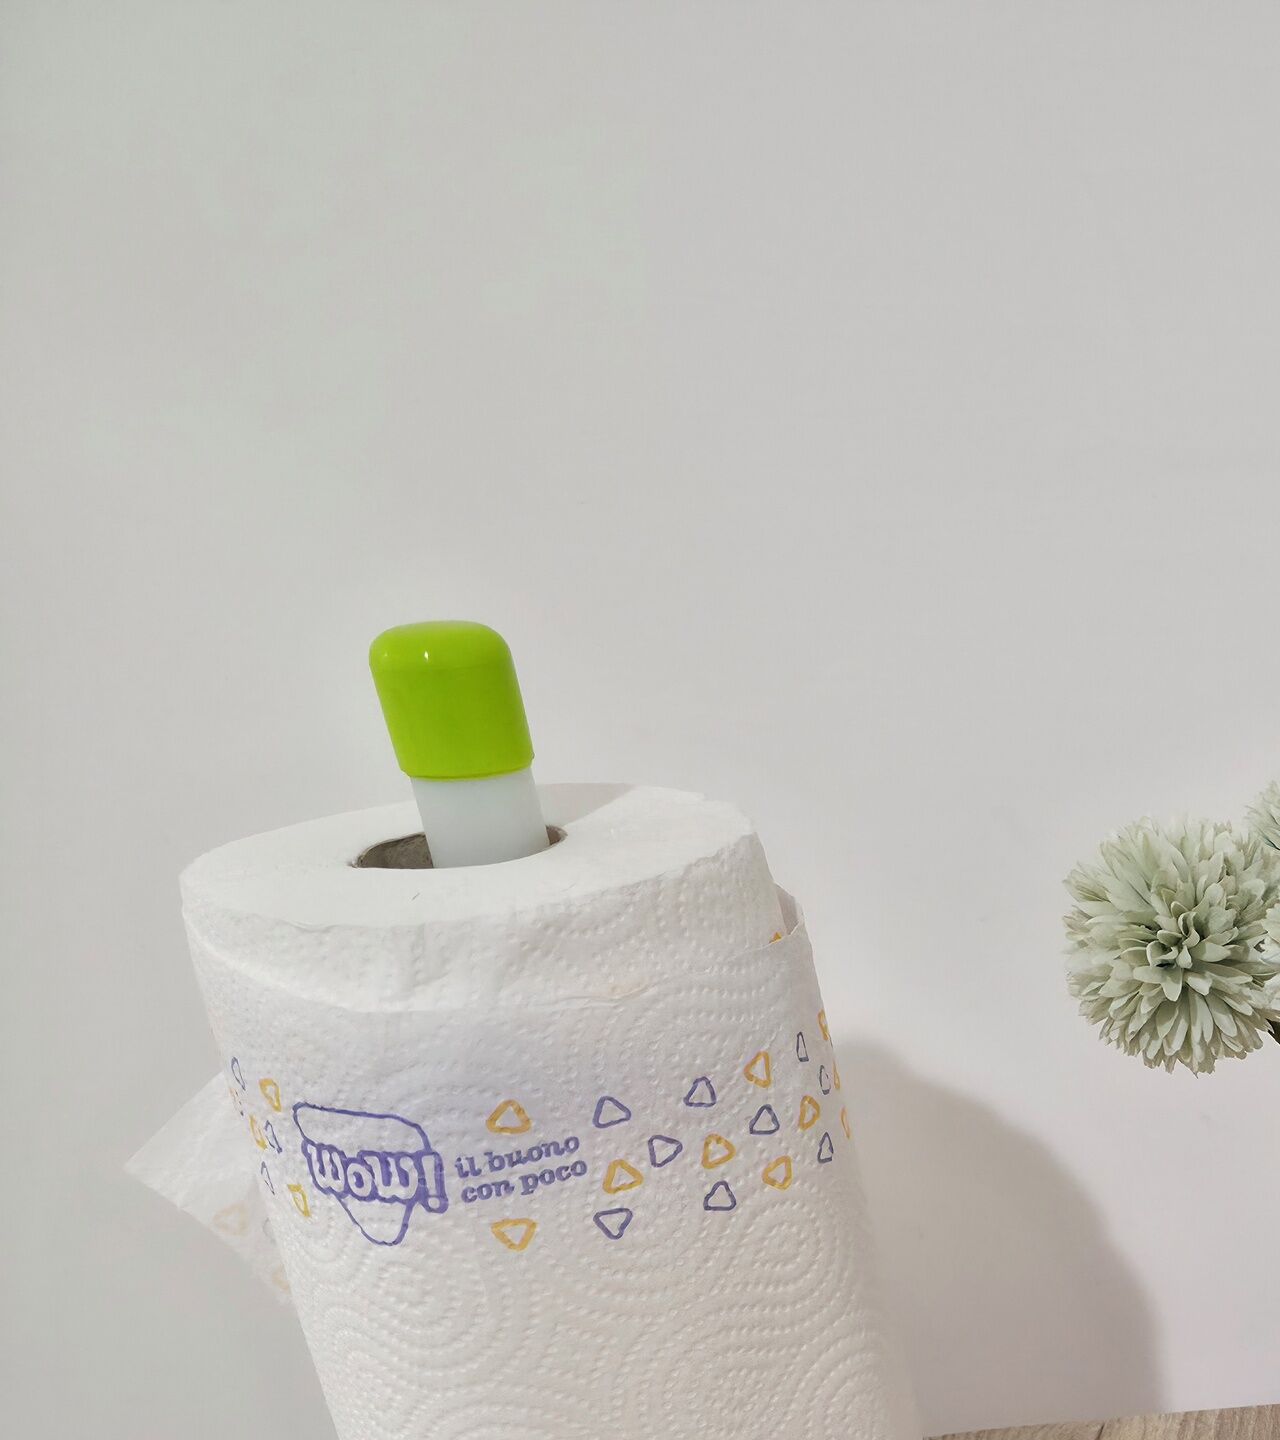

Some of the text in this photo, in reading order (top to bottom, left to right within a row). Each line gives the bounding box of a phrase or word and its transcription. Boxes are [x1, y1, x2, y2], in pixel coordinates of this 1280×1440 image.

[454, 1136, 580, 1178] il buono
[460, 1160, 587, 1202] con poco
